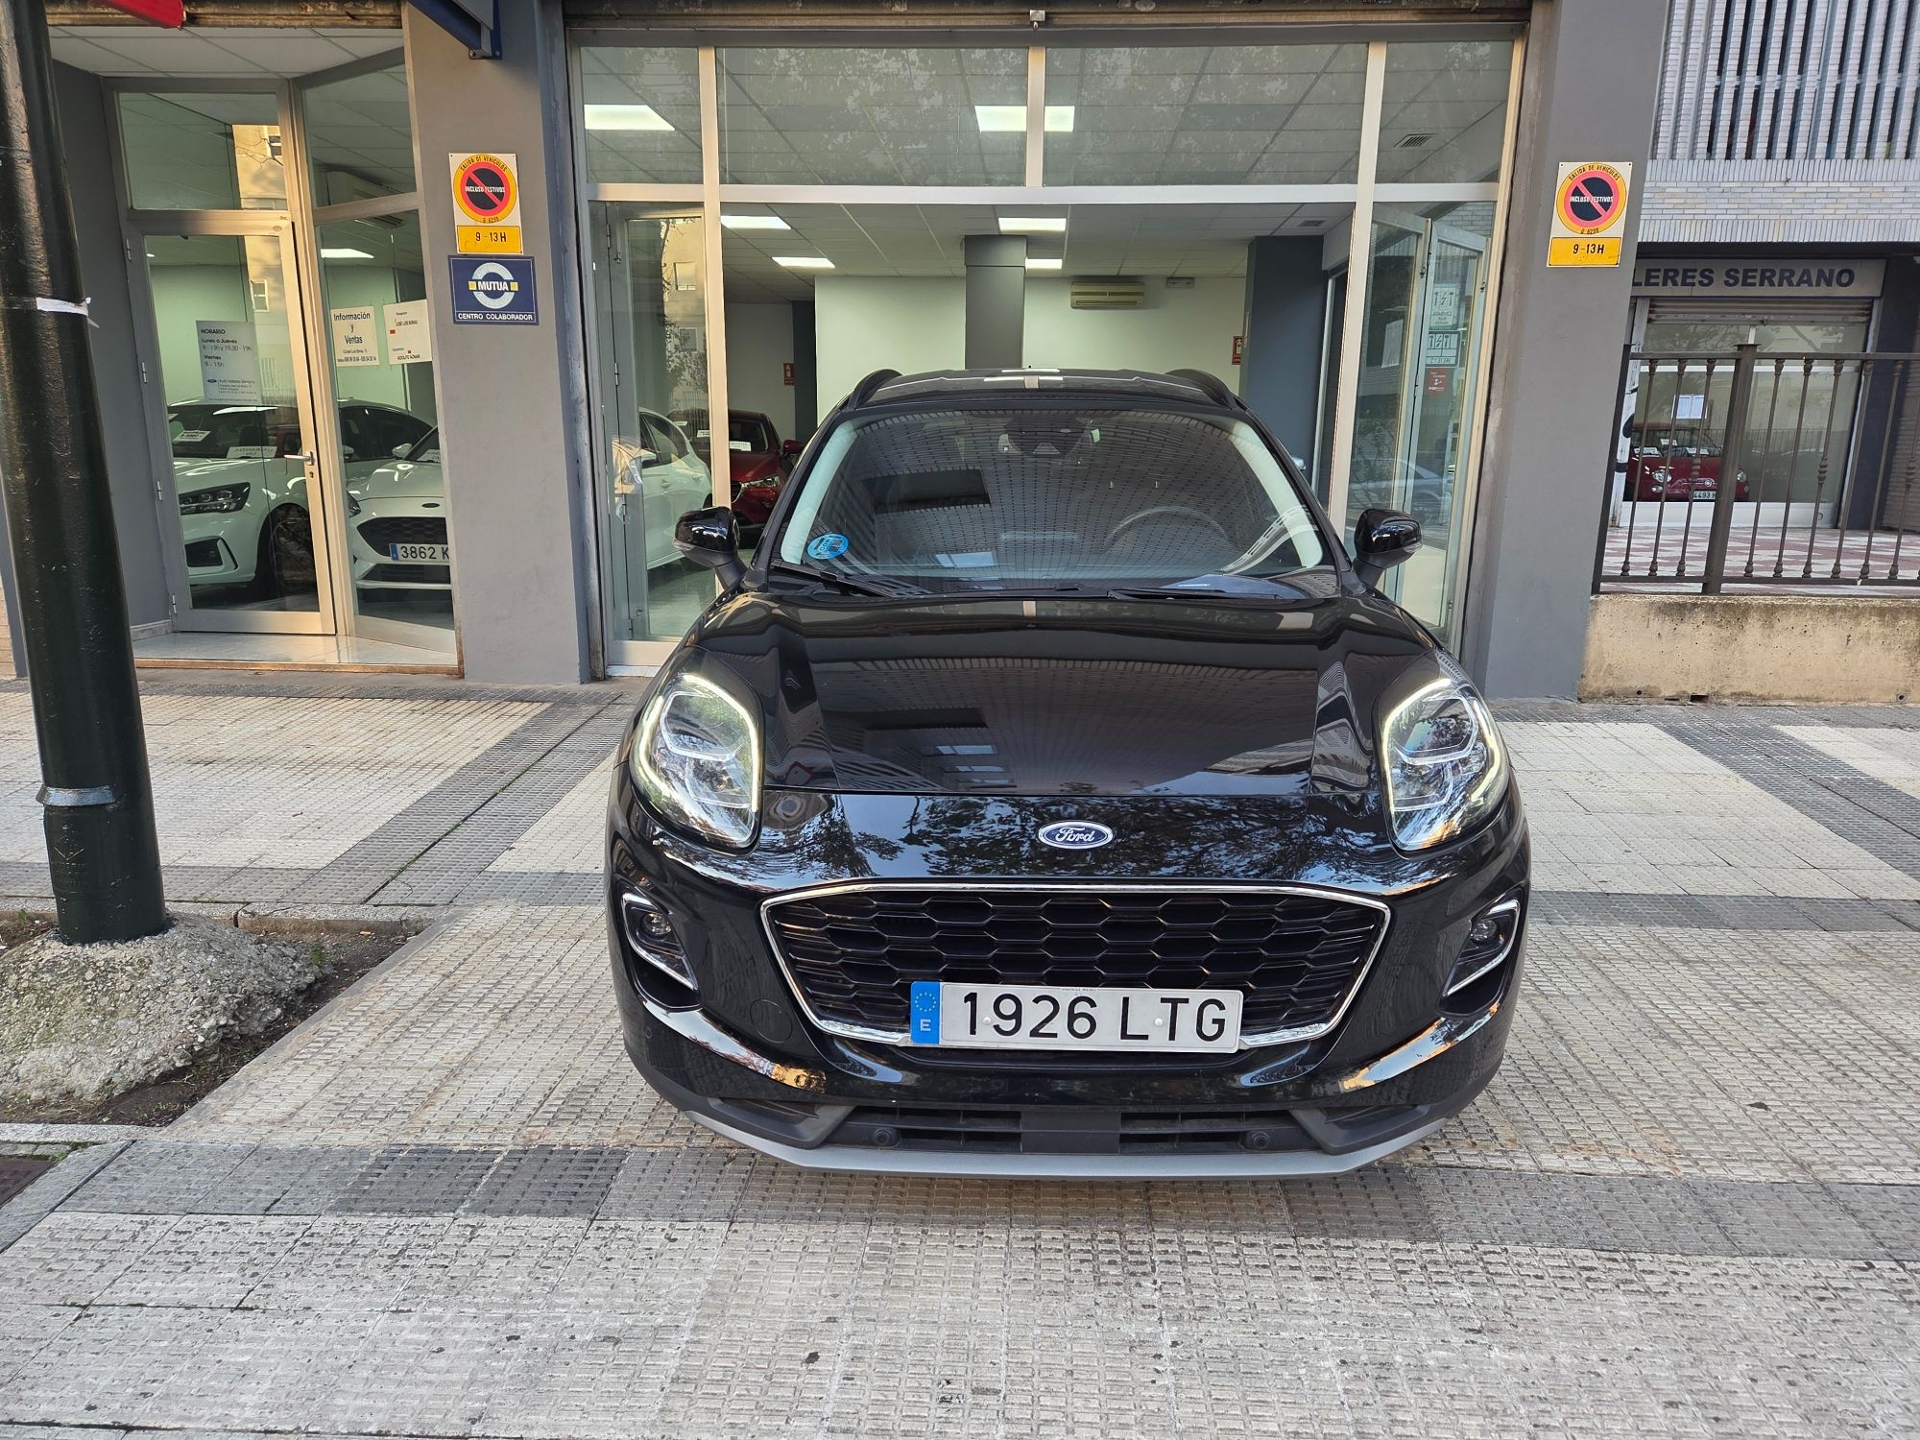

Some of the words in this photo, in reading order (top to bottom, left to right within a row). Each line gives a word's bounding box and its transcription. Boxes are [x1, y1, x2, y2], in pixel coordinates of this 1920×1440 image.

[460, 158, 475, 172] SALIDA
[1568, 167, 1586, 181] SALIDA
[1596, 165, 1620, 181] VEHICULOS
[1723, 268, 1856, 288] SERRANO
[478, 280, 509, 291] MUTUA
[334, 312, 370, 321] Información
[344, 335, 363, 344] Ventas
[400, 545, 437, 560] 3862
[1055, 826, 1095, 842] Ford
[963, 992, 1098, 1040] 1926
[1120, 996, 1227, 1042] LTG
[920, 1019, 932, 1032] E
